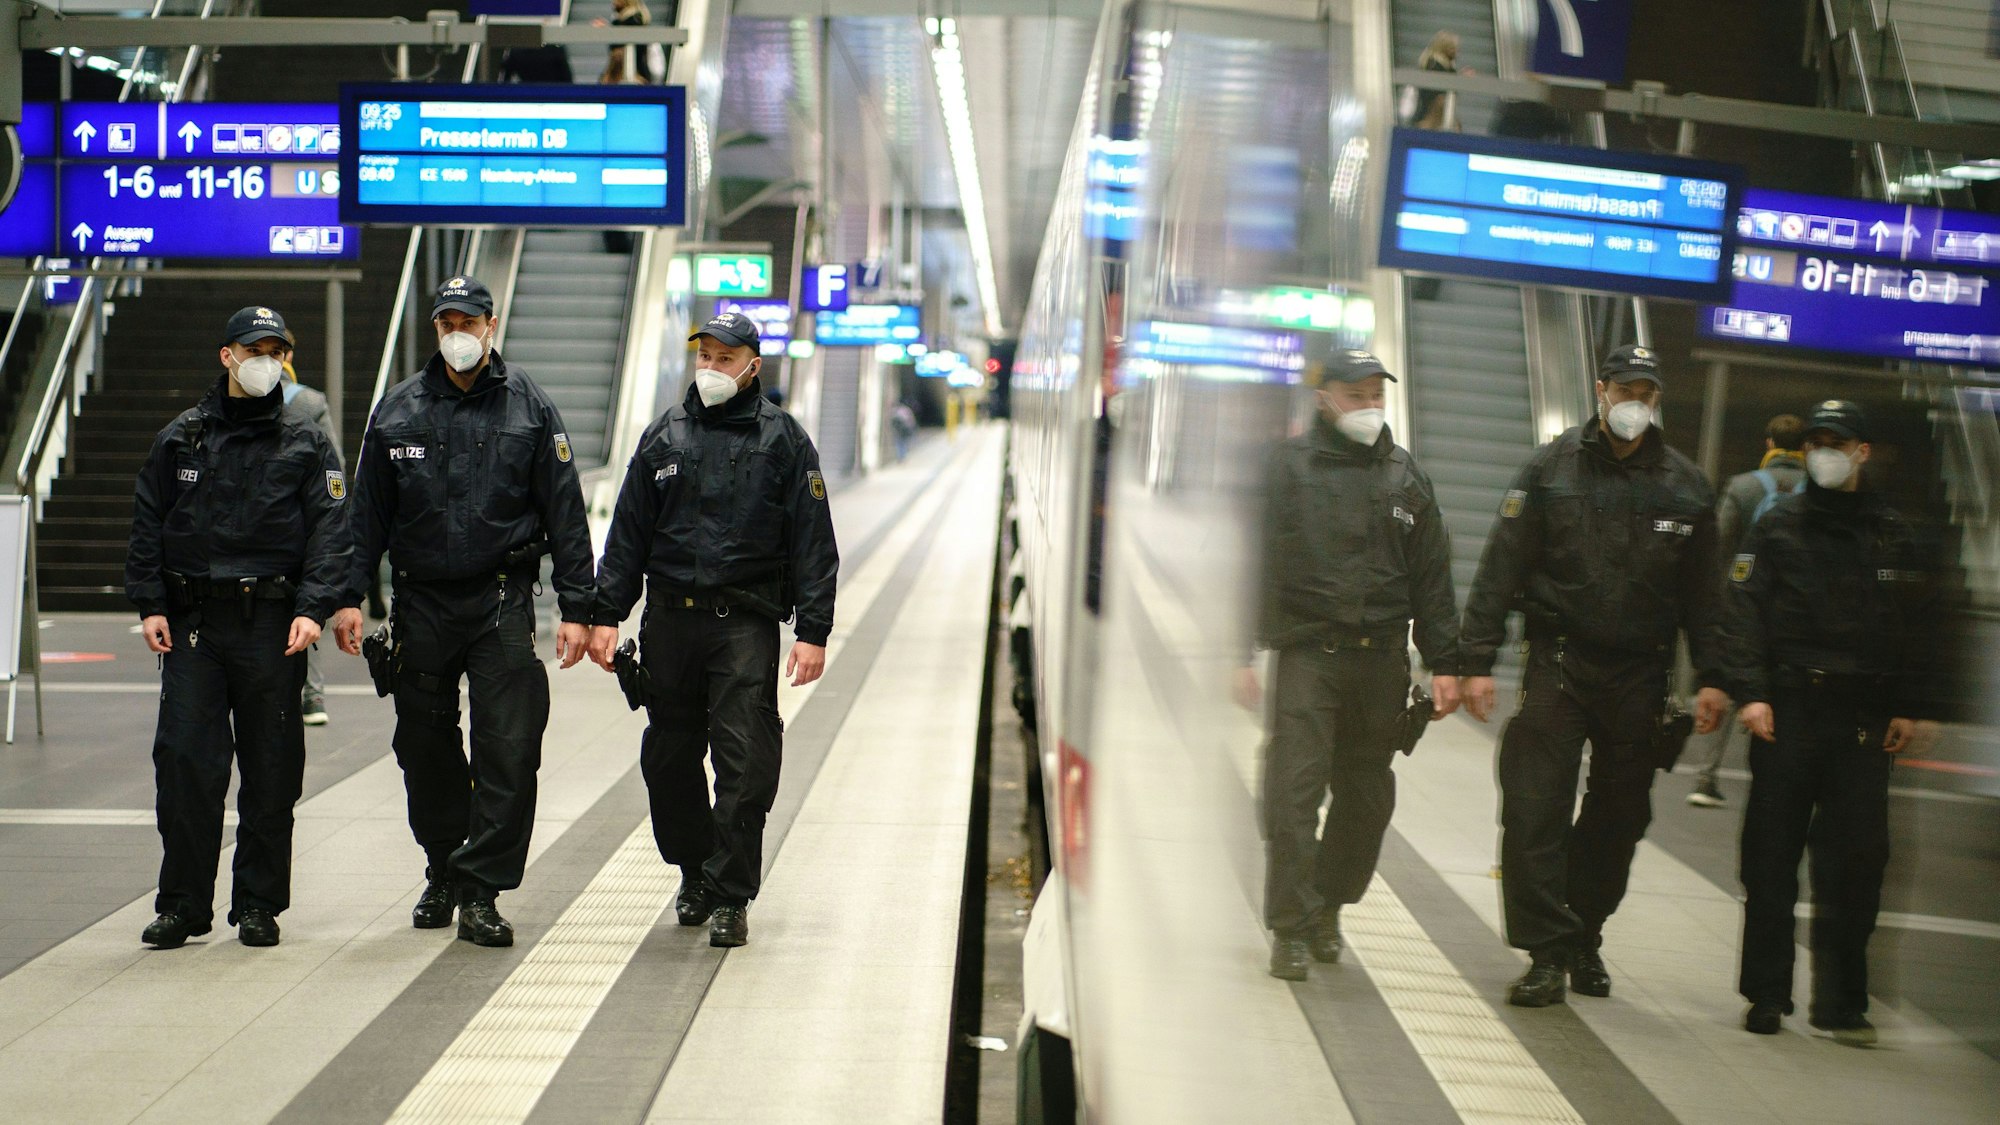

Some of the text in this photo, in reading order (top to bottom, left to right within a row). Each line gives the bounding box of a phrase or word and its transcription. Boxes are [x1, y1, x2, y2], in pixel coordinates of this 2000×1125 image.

[360, 104, 402, 120] 09:25
[420, 127, 568, 149] Pressetermin DB
[103, 165, 155, 199] 1-6
[159, 183, 182, 198] und
[186, 165, 264, 199] 11-16
[298, 170, 316, 194] U
[420, 168, 439, 181] ICE
[103, 225, 154, 243] Ausgang
[443, 289, 468, 297] POLIZEI
[818, 264, 847, 307] F
[390, 446, 425, 460] POLIZEI
[177, 468, 198, 482] LIZEI
